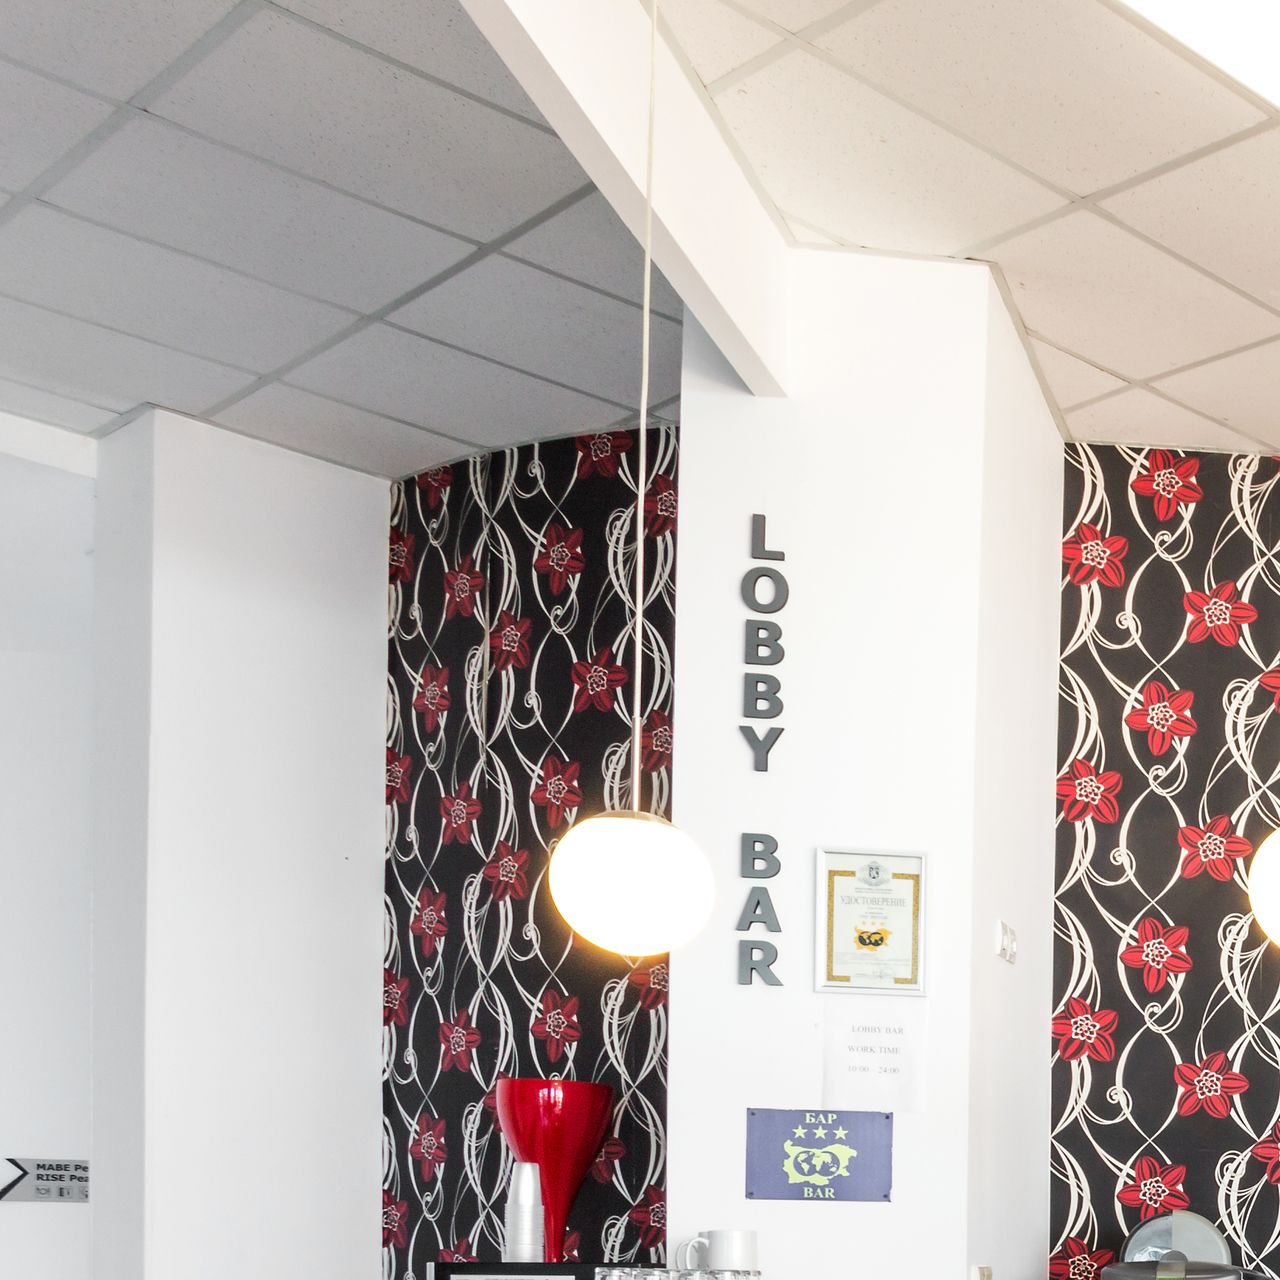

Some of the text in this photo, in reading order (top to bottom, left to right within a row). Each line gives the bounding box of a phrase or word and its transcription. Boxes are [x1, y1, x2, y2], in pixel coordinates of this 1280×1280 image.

[739, 513, 789, 772] LOBBY
[736, 832, 784, 986] BAR
[805, 1112, 837, 1124] БАР
[36, 1173, 66, 1182] RISE
[803, 1187, 835, 1198] BAR
